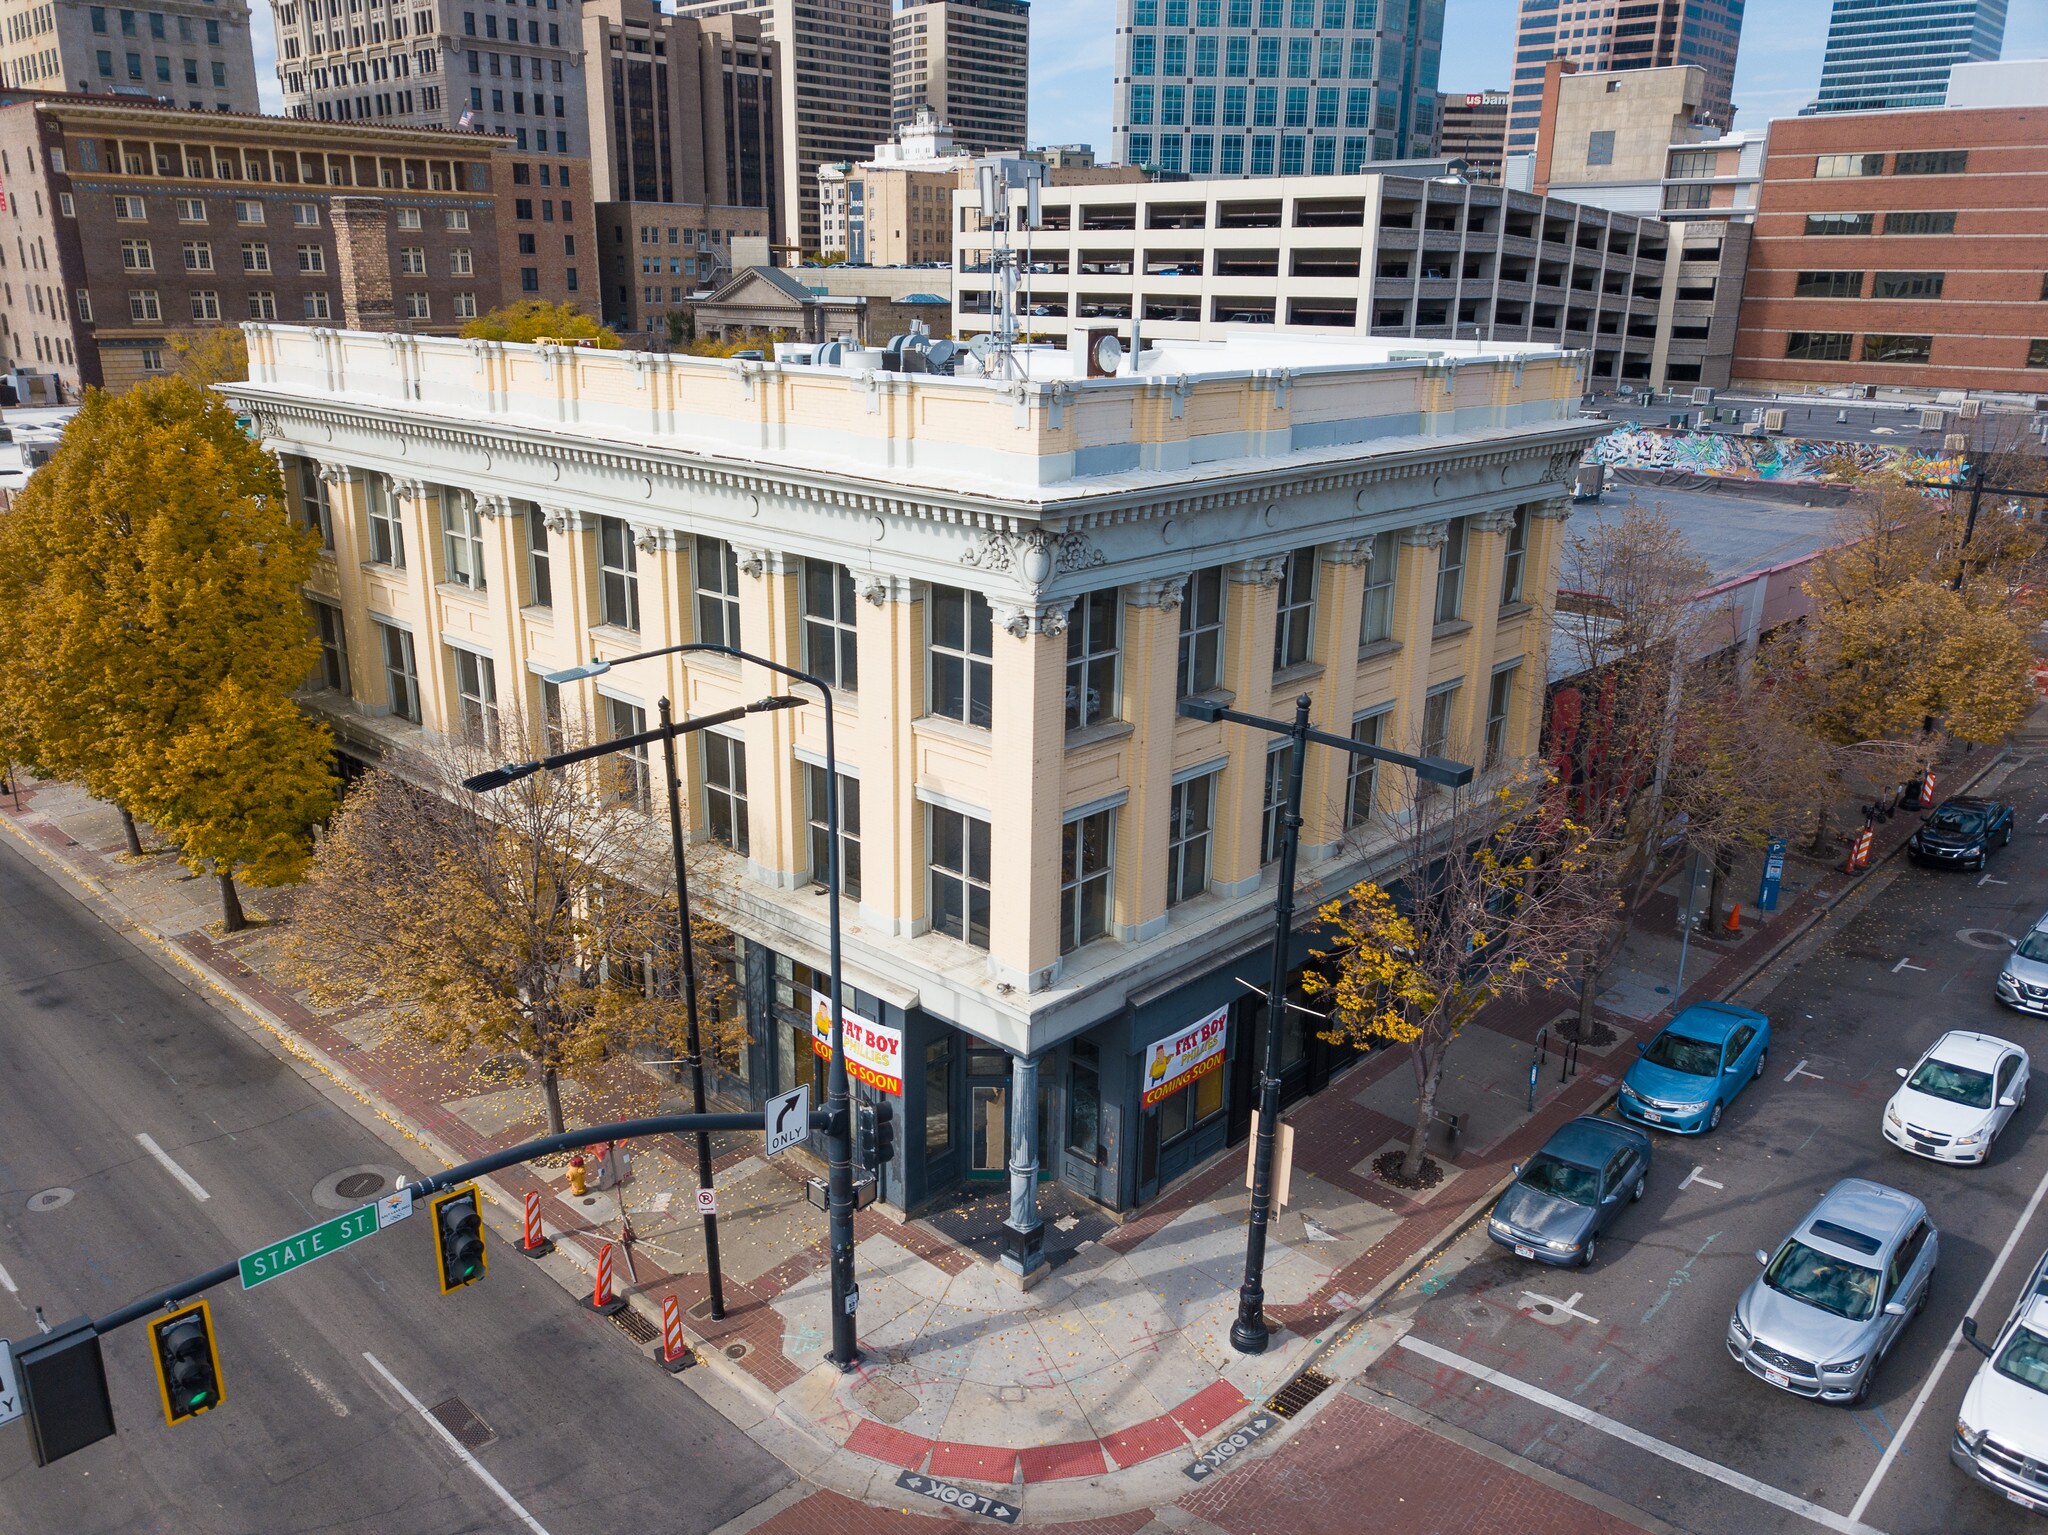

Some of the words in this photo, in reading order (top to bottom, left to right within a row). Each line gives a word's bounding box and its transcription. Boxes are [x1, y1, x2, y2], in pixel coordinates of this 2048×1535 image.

[866, 1029, 899, 1055] BOY
[1175, 1030, 1199, 1056] FAT
[1201, 1014, 1227, 1042] BOY
[843, 1036, 890, 1067] PHILLIES
[1181, 1036, 1219, 1067] PHILLIES
[859, 1066, 898, 1092] SOON
[1146, 1071, 1191, 1104] COMING
[1192, 1052, 1222, 1079] SOON
[772, 1126, 802, 1149] ONLY
[254, 1232, 325, 1276] STATE
[340, 1214, 370, 1239] ST.
[1202, 1425, 1260, 1467] LOOK
[924, 1480, 993, 1514] LOOK
